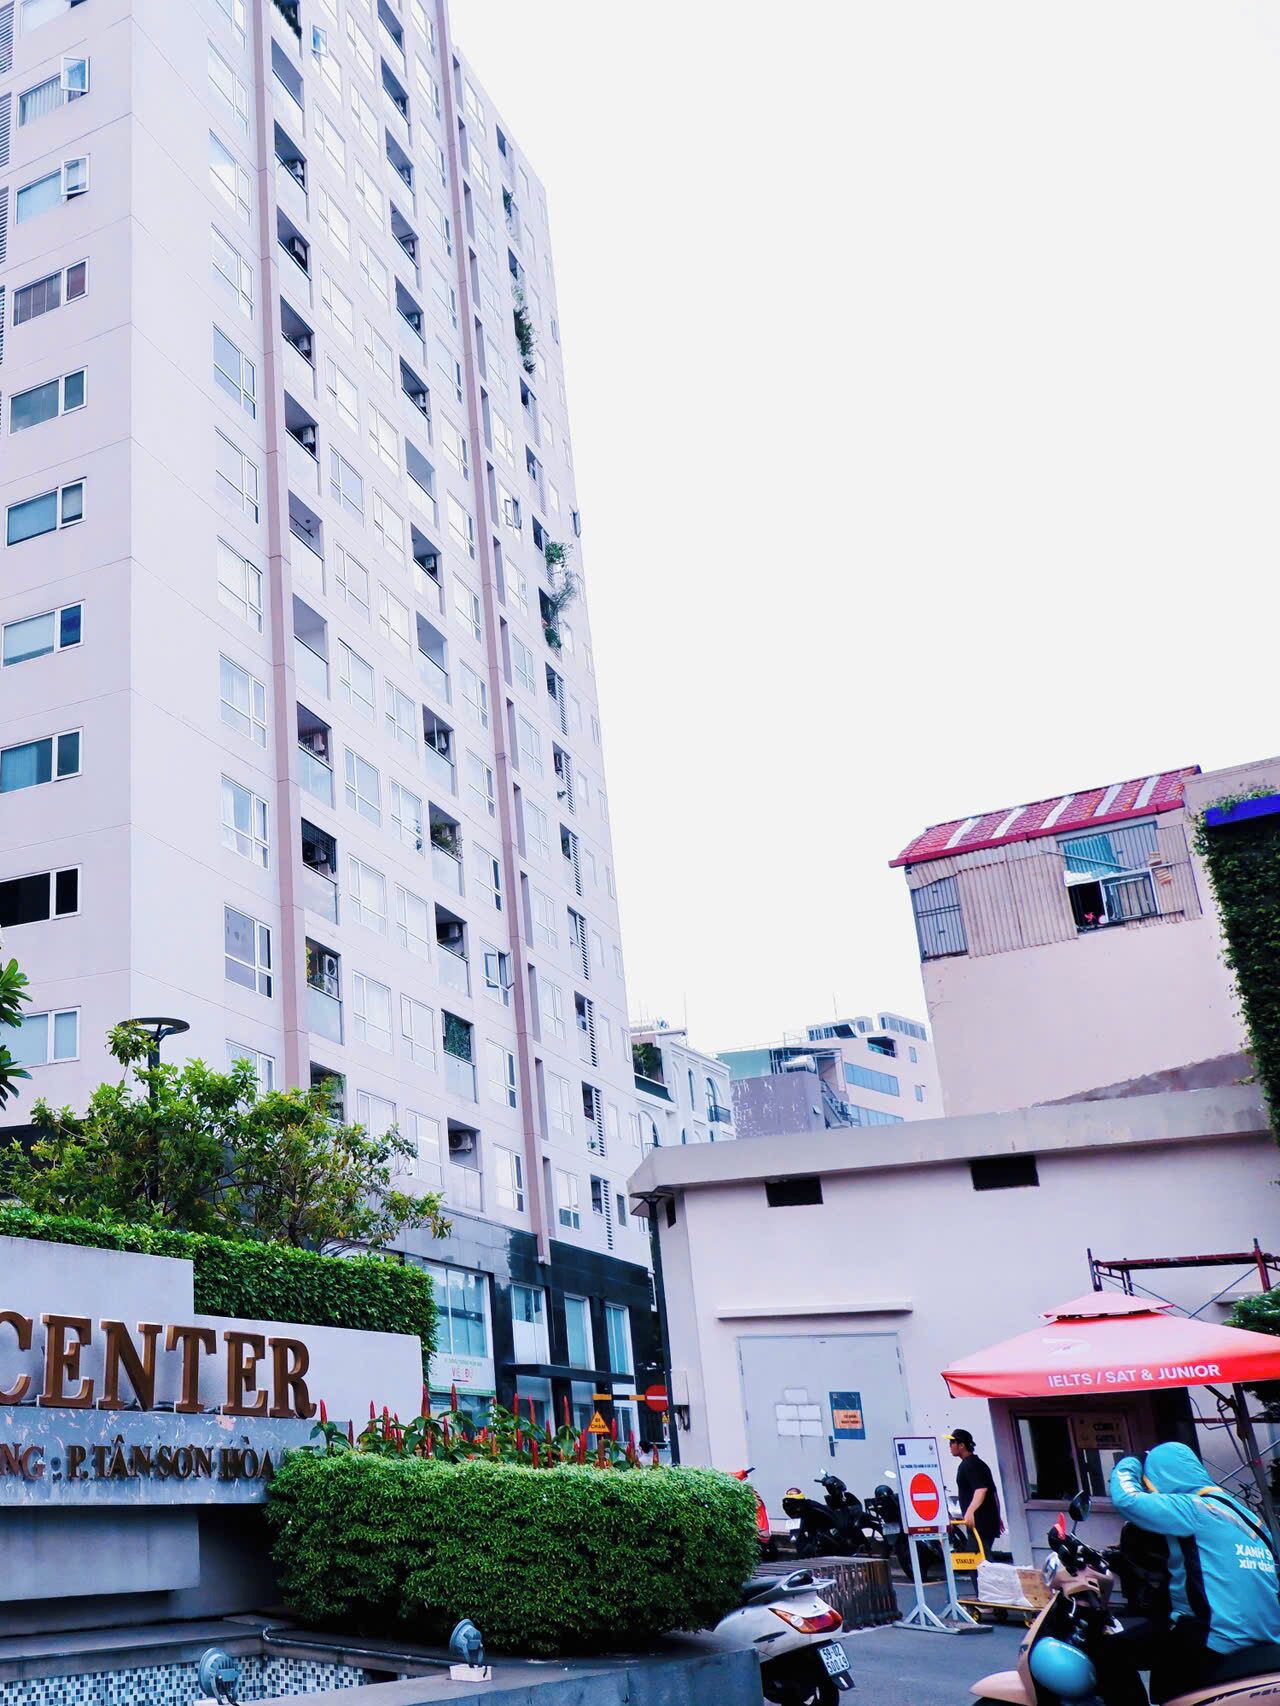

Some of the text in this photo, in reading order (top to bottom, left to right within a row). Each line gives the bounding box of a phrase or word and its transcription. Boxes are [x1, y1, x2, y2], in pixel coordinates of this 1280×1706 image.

[1048, 1363, 1221, 1388] IELTS / SAT & JUNIOR
[219, 1434, 275, 1480] HÒA
[1234, 1543, 1274, 1561] XANH S
[1238, 1557, 1275, 1573] xin chà
